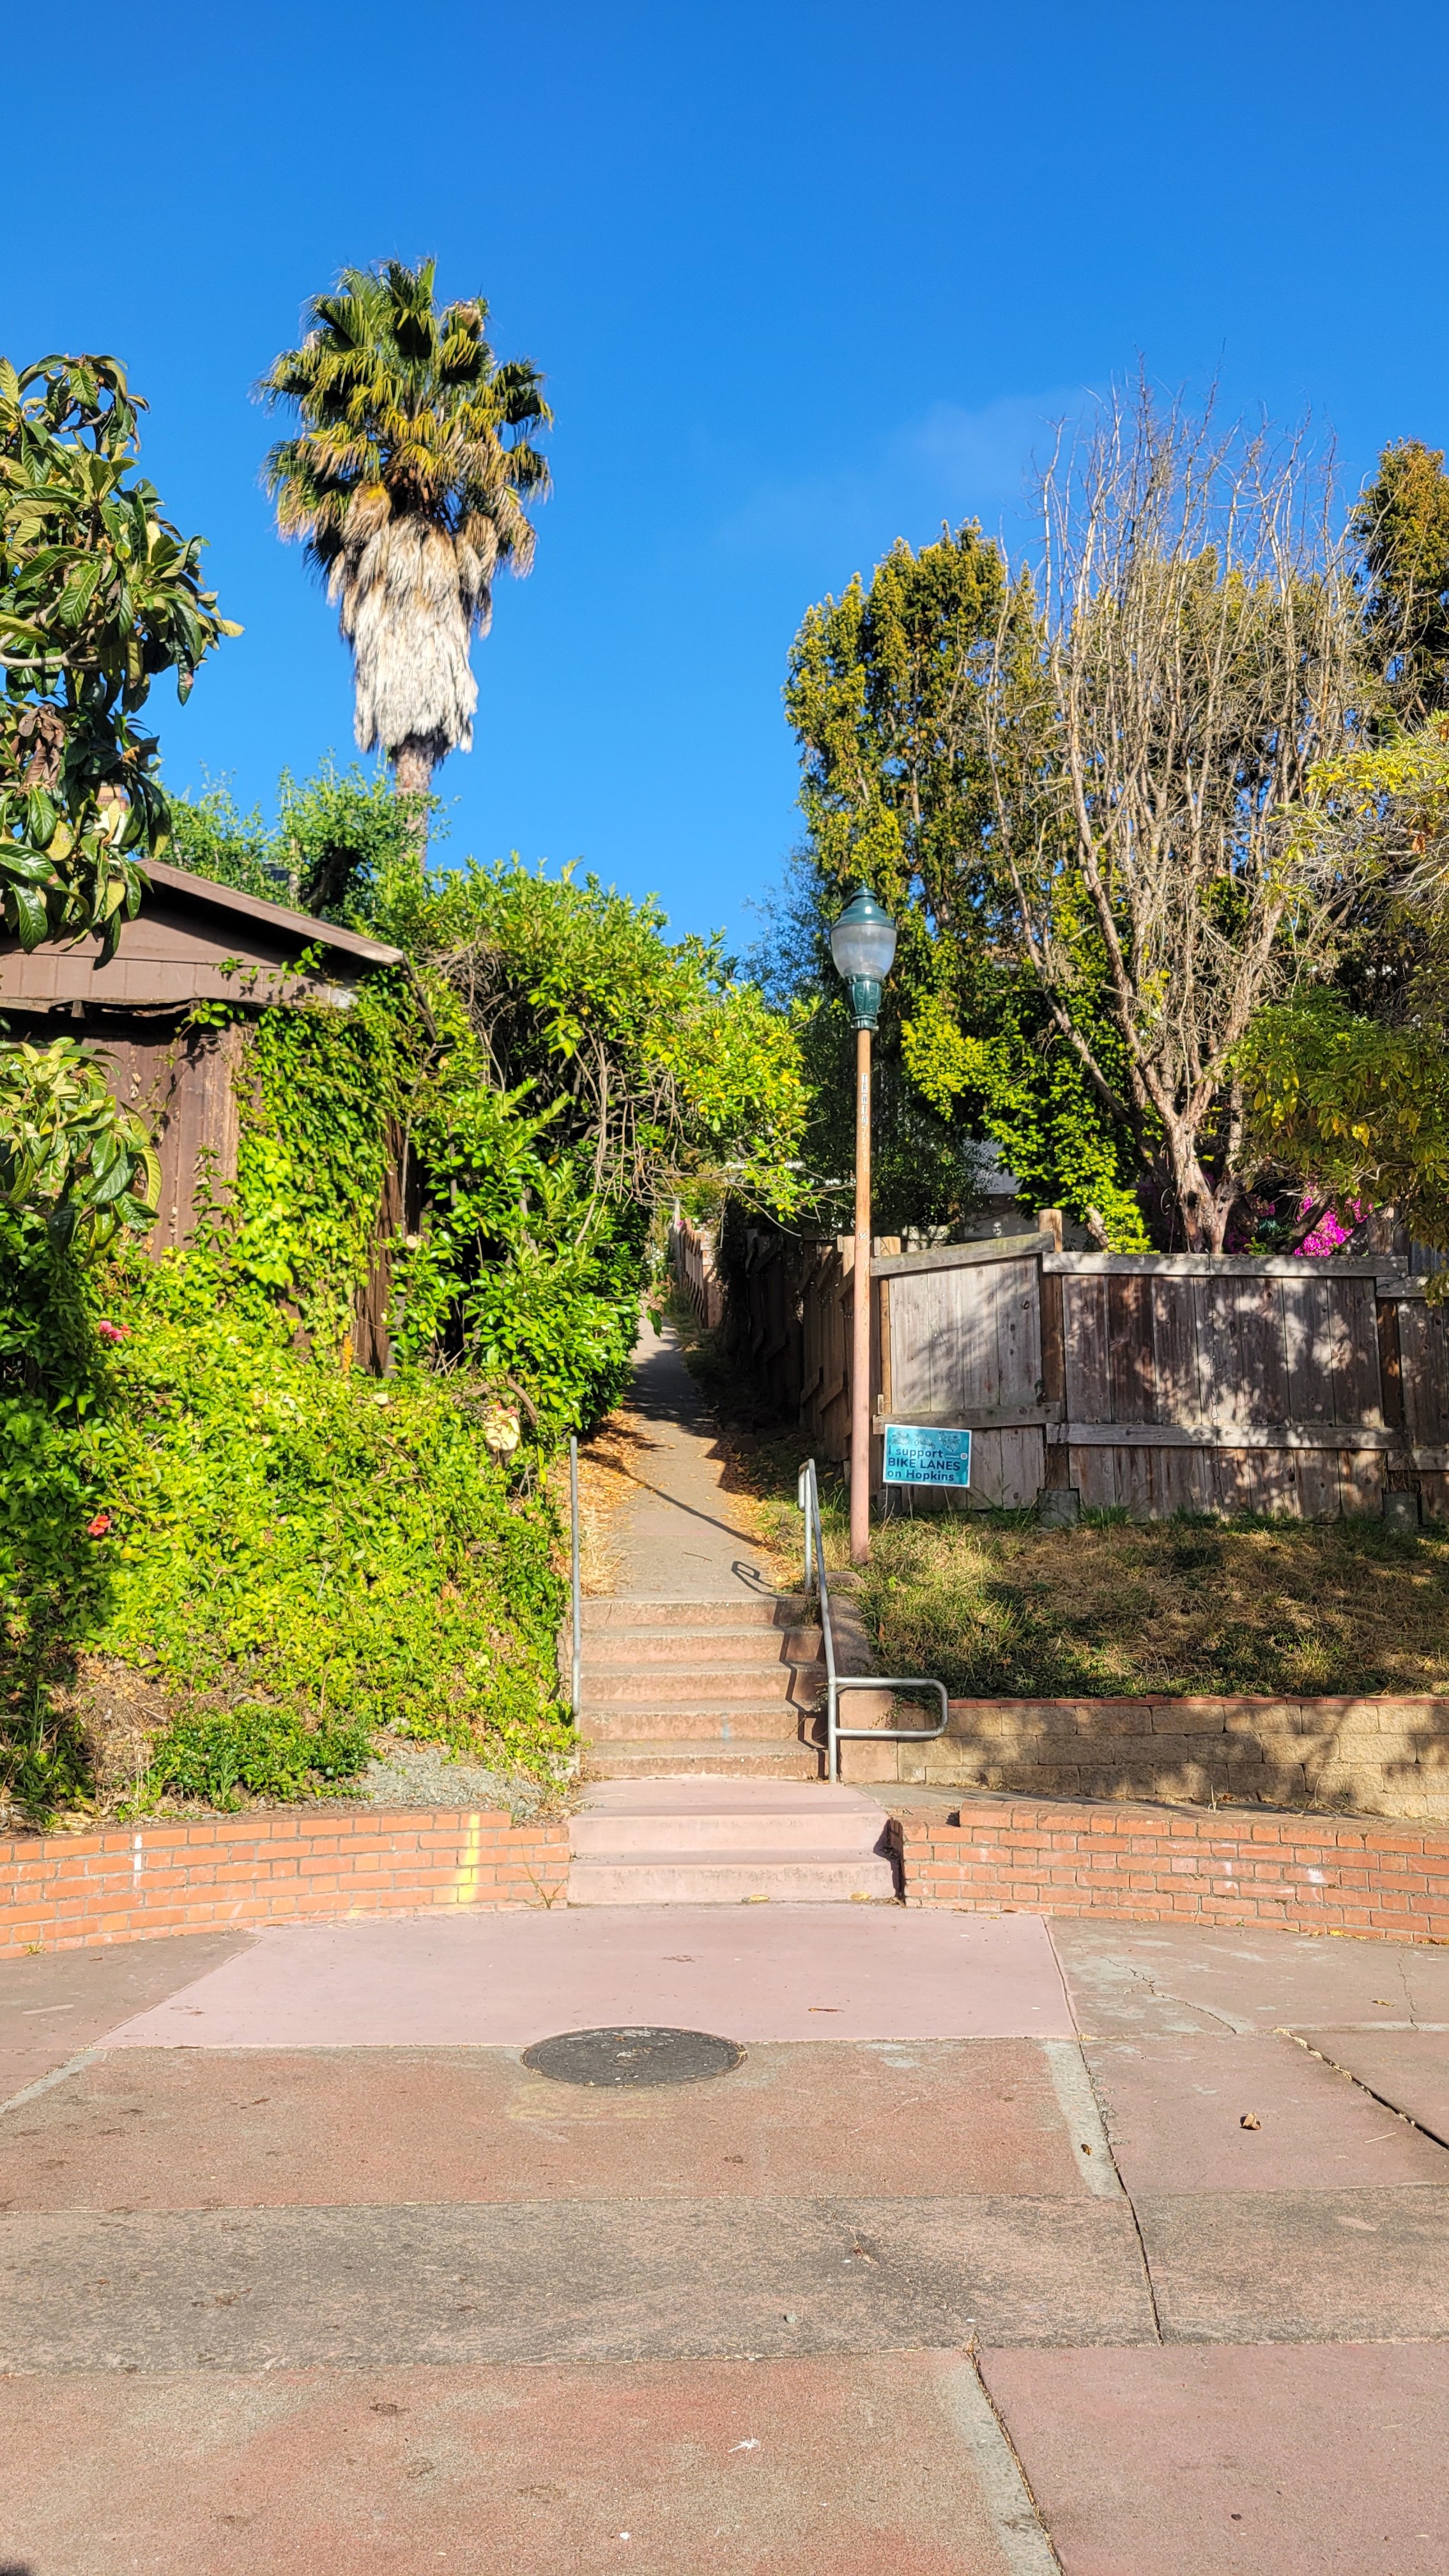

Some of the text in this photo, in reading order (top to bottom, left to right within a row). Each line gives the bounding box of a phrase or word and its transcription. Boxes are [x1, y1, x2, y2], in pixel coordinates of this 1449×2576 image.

[889, 1446, 944, 1459] I support
[888, 1457, 960, 1471] BIKE LANES
[887, 1469, 954, 1482] on Hopkins
